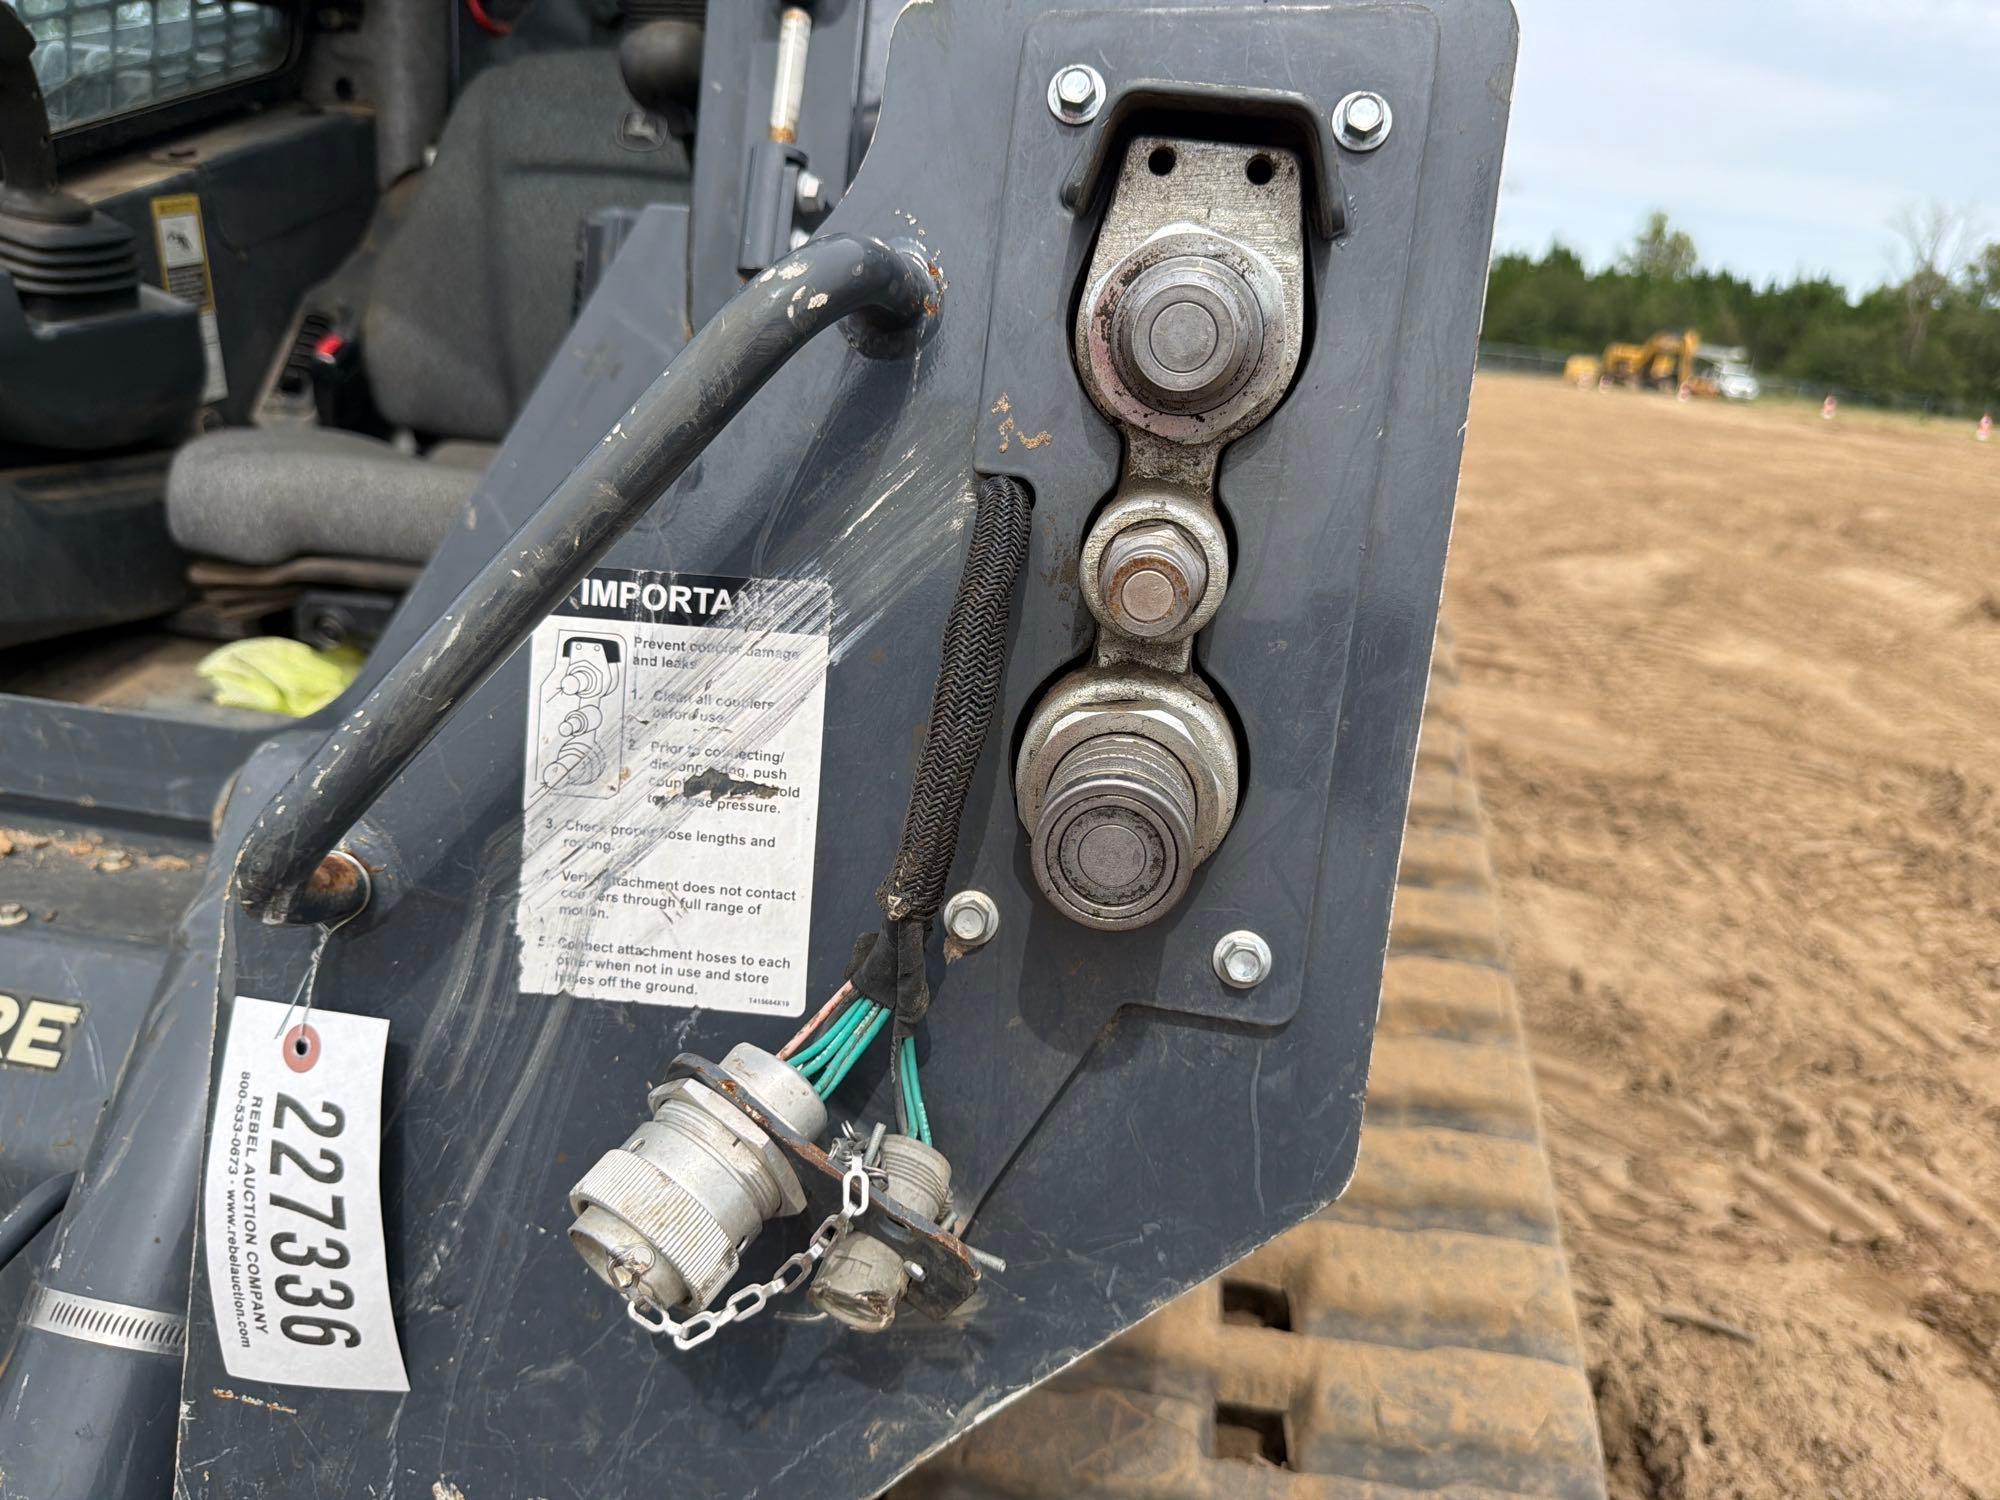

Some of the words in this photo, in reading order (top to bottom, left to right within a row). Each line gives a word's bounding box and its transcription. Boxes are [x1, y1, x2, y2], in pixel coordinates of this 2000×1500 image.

[633, 636, 687, 652] Prevent
[632, 655, 658, 667] and
[630, 688, 643, 700] 1.
[695, 694, 713, 706] all
[715, 696, 775, 711] coulers
[652, 706, 698, 721] befor
[650, 741, 685, 754] Prior
[704, 747, 786, 766] coecting/
[753, 768, 788, 781] push
[774, 785, 801, 799] old
[716, 800, 782, 815] pressure.
[545, 817, 557, 830] 3.
[610, 825, 661, 839] prop
[664, 829, 693, 842] ose
[696, 830, 747, 847] lengths
[750, 836, 777, 848] and
[563, 838, 616, 854] rong.
[562, 870, 600, 884] Veri
[604, 875, 680, 890] ttachment
[682, 881, 716, 894] does
[719, 885, 743, 897] not
[745, 888, 797, 901] contact
[559, 904, 610, 919] motion.
[560, 889, 619, 903] couers
[623, 893, 676, 910] through
[680, 897, 702, 910] full
[704, 902, 744, 916] range
[747, 903, 763, 915] of
[557, 936, 614, 953] Connect
[616, 943, 693, 961] attachment
[696, 949, 738, 964] hoses
[741, 954, 755, 966] to
[758, 957, 792, 969] each
[554, 969, 595, 985] hes
[598, 975, 618, 988] off
[620, 977, 642, 990] the
[645, 982, 699, 996] ground.
[594, 958, 631, 972] when
[634, 963, 657, 975] not
[660, 963, 674, 975] in
[677, 967, 702, 978] use
[705, 969, 731, 981] and
[734, 972, 770, 984] store
[228, 1070, 251, 1176] 800-533-0673
[245, 1095, 263, 1158] REBEL
[243, 1163, 258, 1246] AUCTION
[269, 1092, 362, 1348] 227336
[226, 1189, 251, 1348] www.rebelauction.com
[246, 1251, 269, 1335] COMPANY
